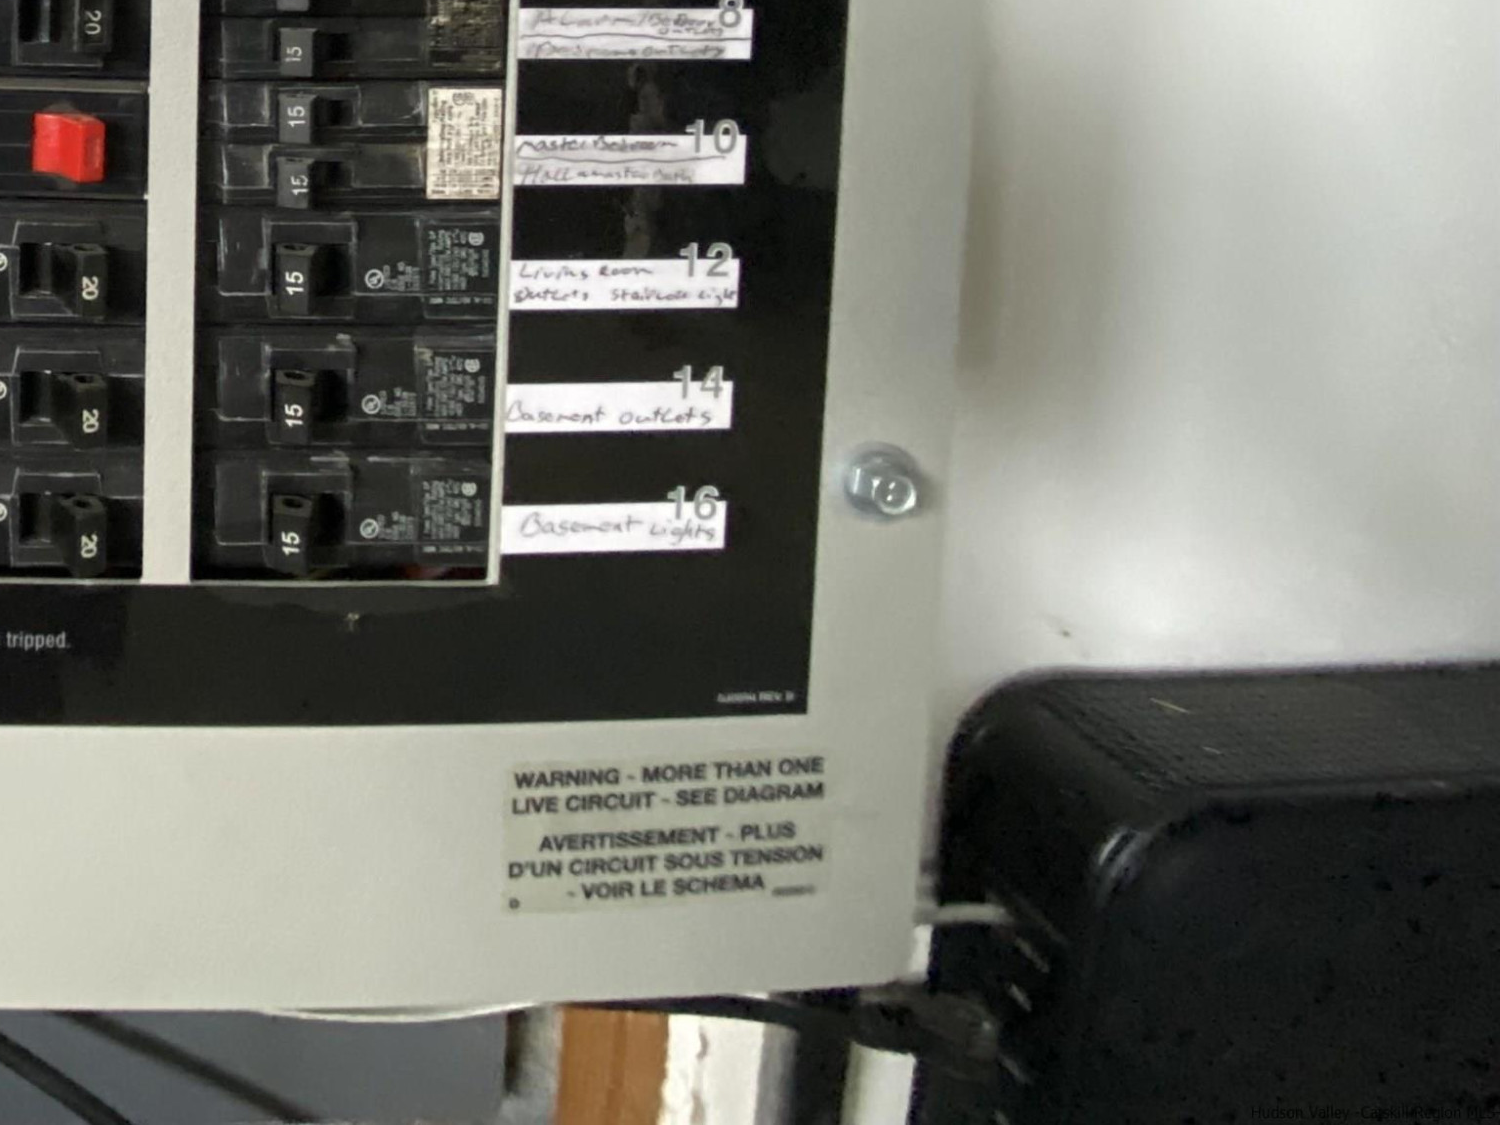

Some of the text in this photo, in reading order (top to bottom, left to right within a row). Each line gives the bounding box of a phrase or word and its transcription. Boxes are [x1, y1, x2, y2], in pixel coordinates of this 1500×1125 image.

[84, 10, 102, 35] 20
[285, 46, 302, 63] 15
[287, 105, 306, 128] 15
[685, 119, 740, 154] 10
[291, 174, 309, 196] 15
[679, 242, 733, 277] 12
[81, 275, 98, 301] 20
[285, 271, 304, 296] 15
[673, 365, 725, 399] 14
[82, 409, 99, 434] 20
[284, 403, 303, 428] 15
[667, 484, 720, 520] 16
[80, 534, 98, 559] 20
[281, 530, 300, 556] 15
[6, 630, 71, 652] tripped.
[514, 768, 620, 790] WARNING
[642, 763, 707, 784] MORE
[713, 759, 772, 779] THAN
[778, 756, 824, 775] ONE
[512, 796, 559, 814] LIVE
[565, 791, 655, 813] CIRCUIT
[675, 787, 717, 806] SEE
[723, 781, 824, 804] DIAGRAM
[538, 826, 721, 852] AVERTISSEMENT
[740, 821, 797, 842] PLUS
[508, 845, 824, 879] D'UN CIRCUIT SOUS TENSION
[581, 881, 635, 901] VOIR
[640, 879, 667, 897] LE
[673, 875, 765, 896] SCHEMA
